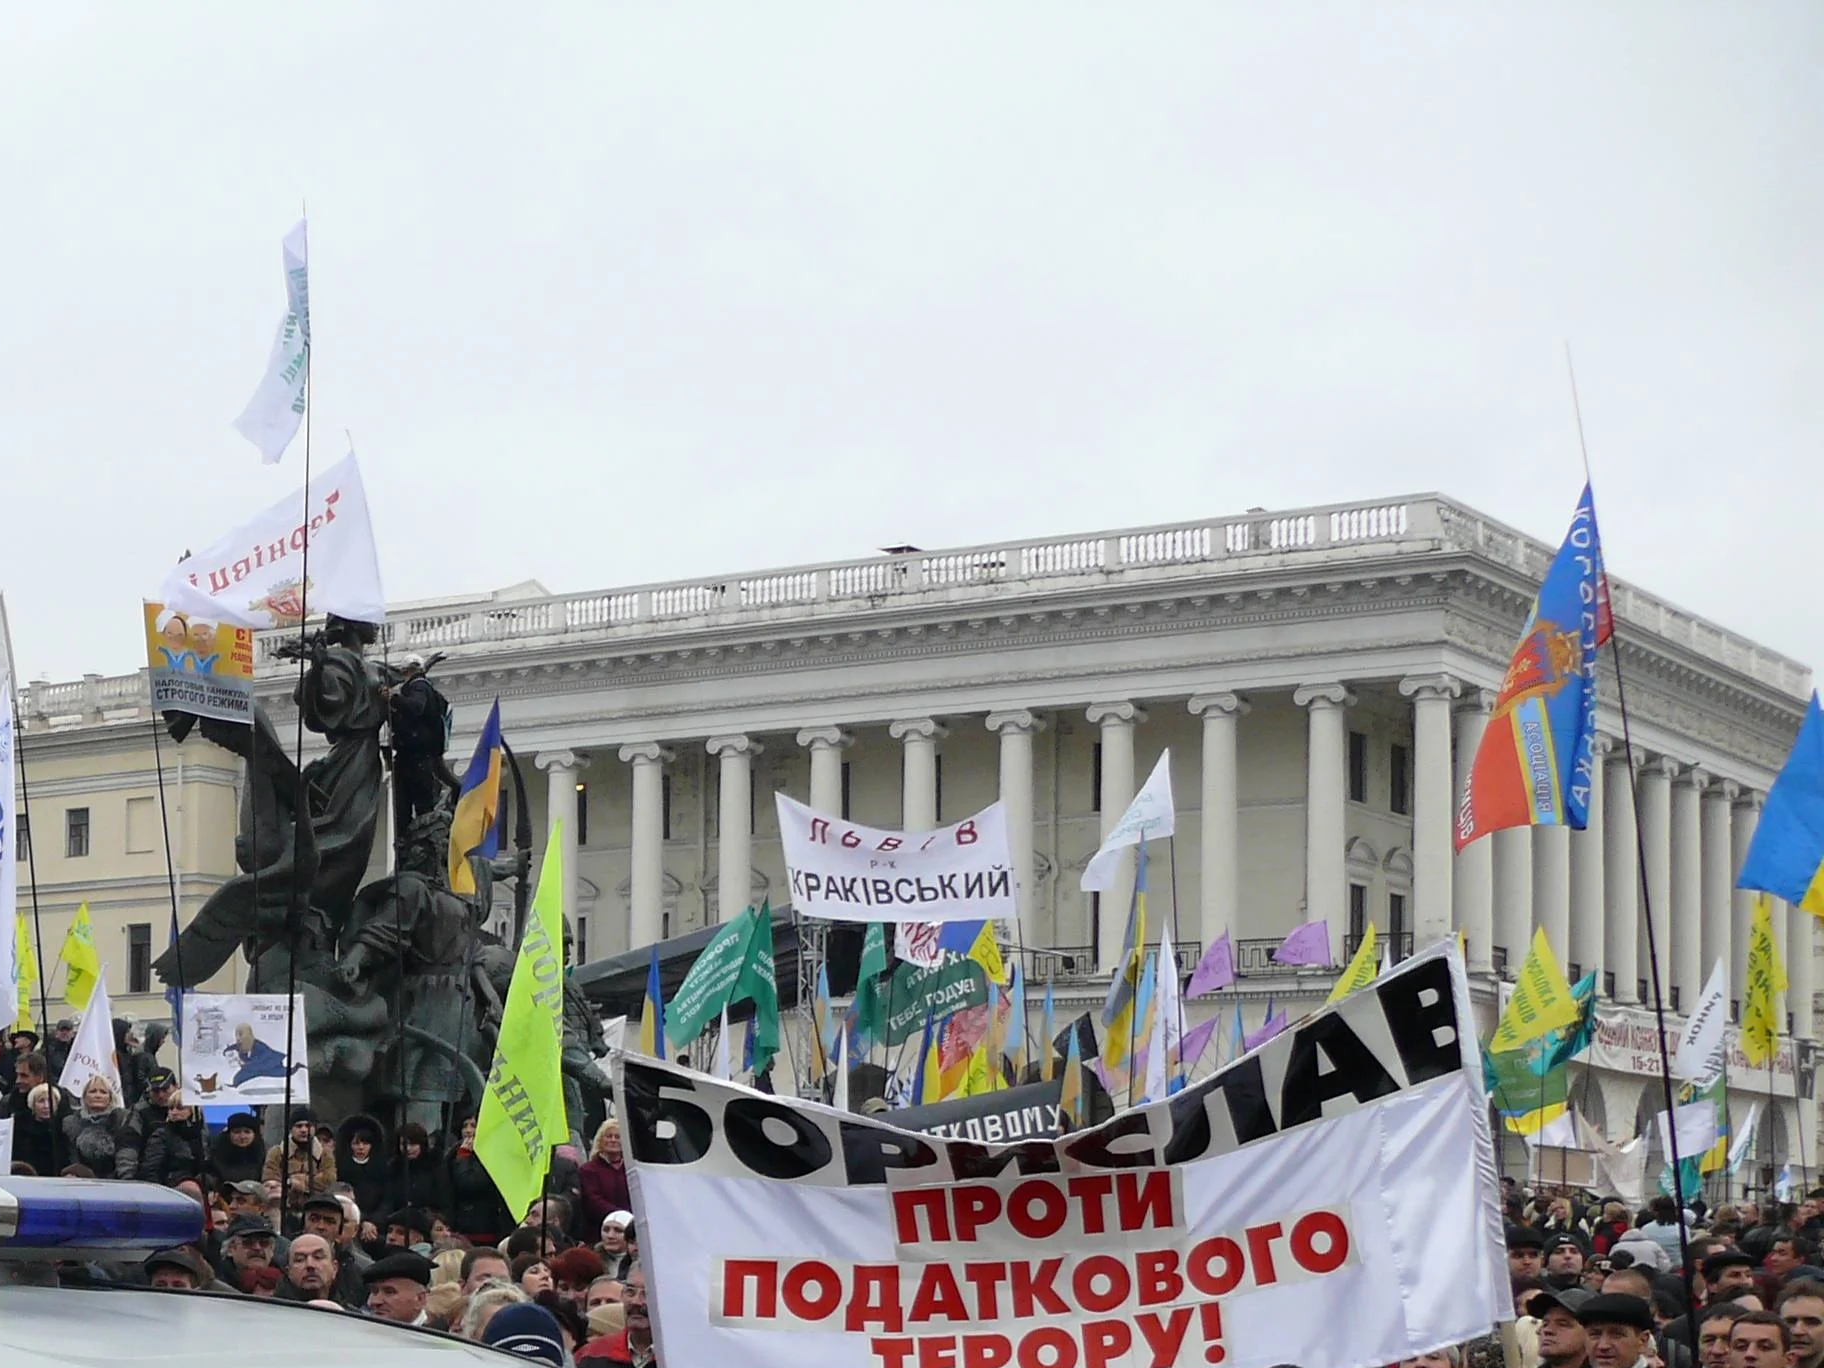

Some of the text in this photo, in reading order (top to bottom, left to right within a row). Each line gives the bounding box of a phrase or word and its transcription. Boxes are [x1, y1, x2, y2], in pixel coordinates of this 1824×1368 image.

[156, 688, 249, 712] СТРОГОГО РЕЖИМА
[809, 817, 978, 852] ЛЬВІВ
[890, 1001, 922, 1031] ТЕБЕ
[622, 956, 1463, 1186] БОРИСЛАВ
[919, 1104, 1061, 1142] ТКОВОМУ
[892, 1170, 1175, 1246] ПРОТИ
[722, 1210, 1350, 1334] ПОДАТКОВОГО
